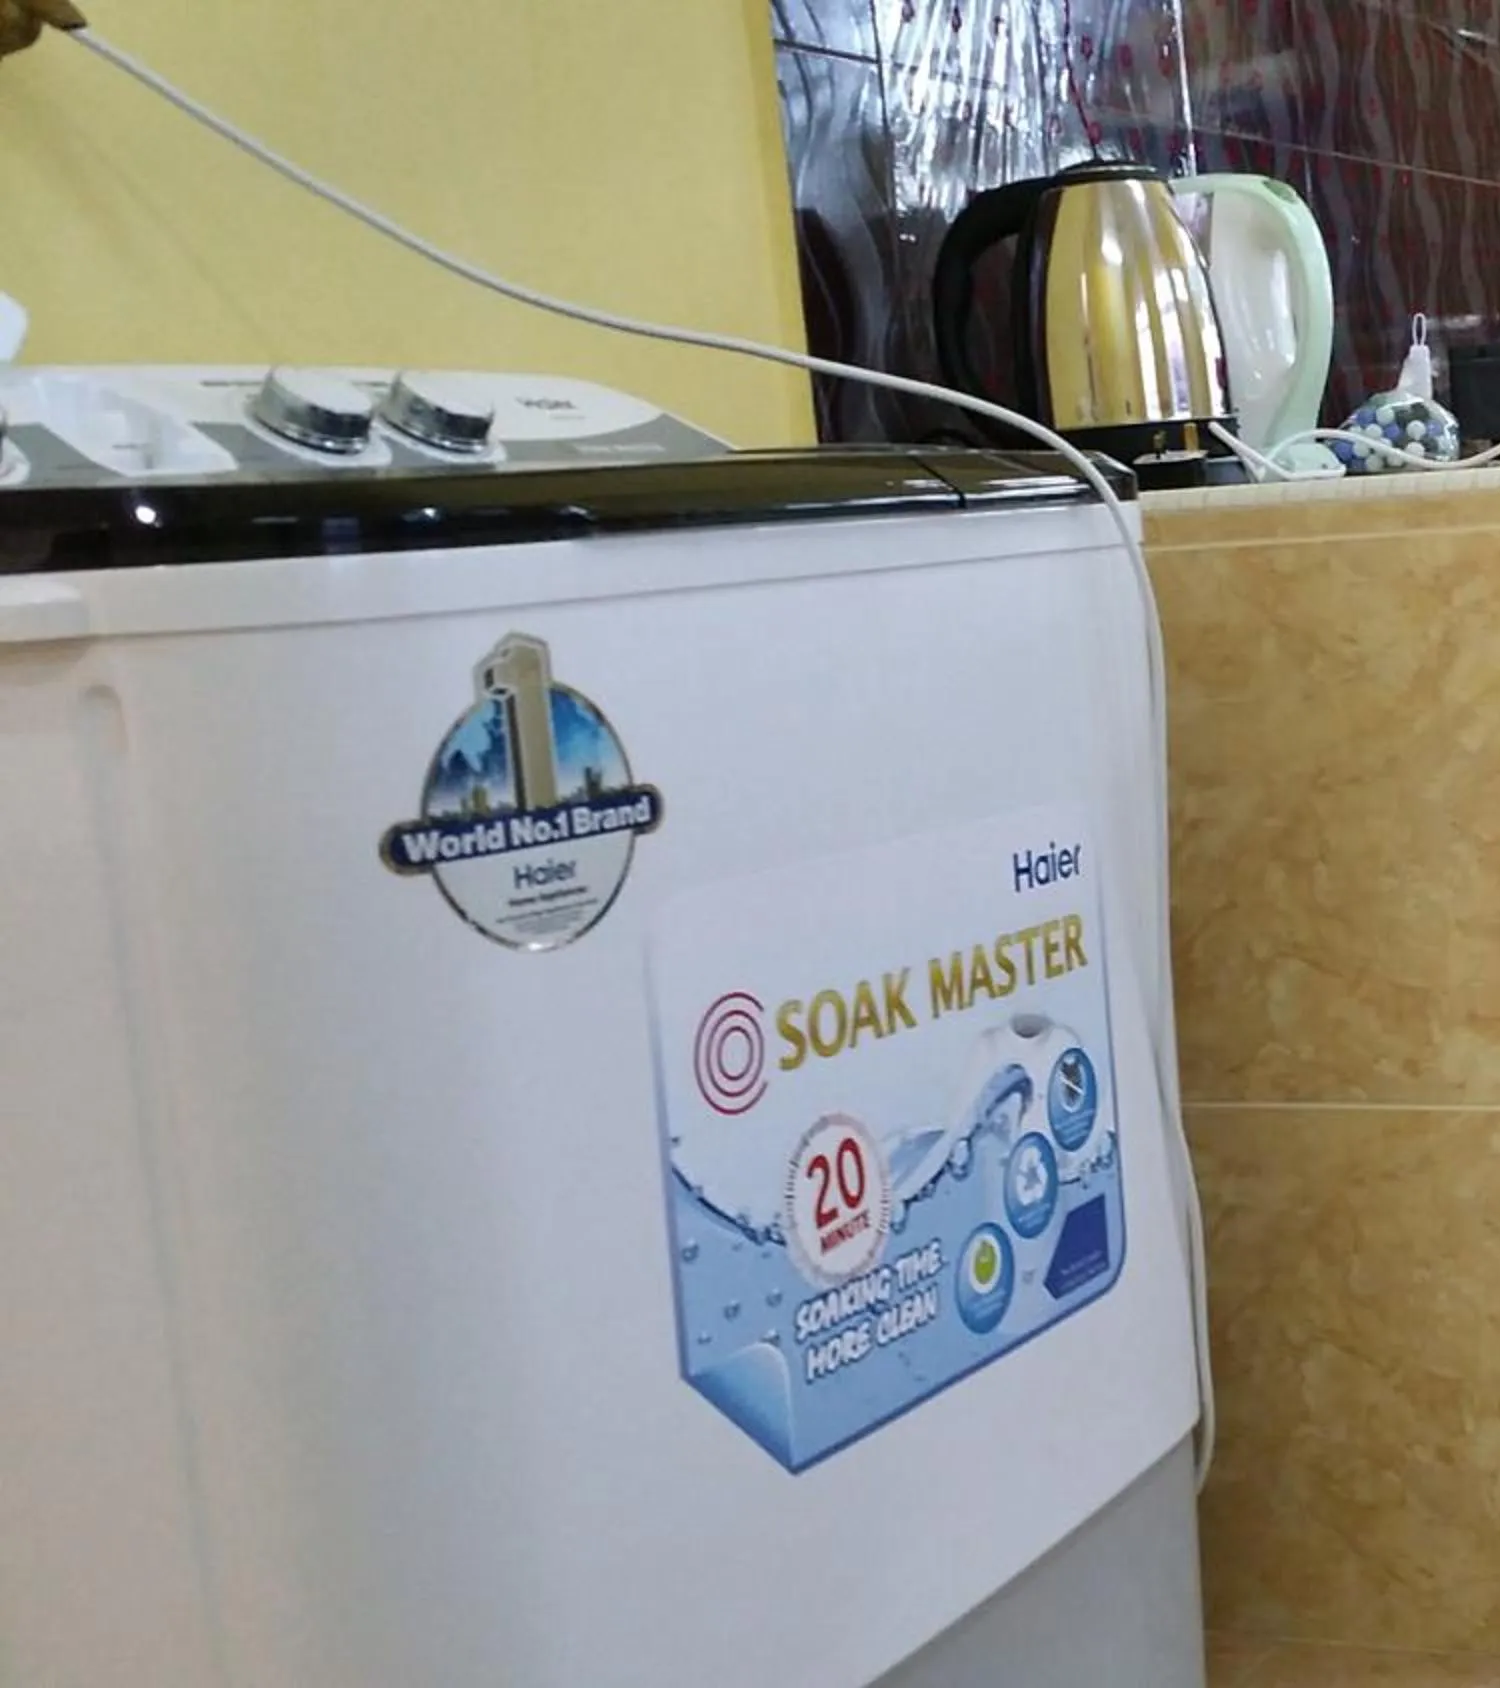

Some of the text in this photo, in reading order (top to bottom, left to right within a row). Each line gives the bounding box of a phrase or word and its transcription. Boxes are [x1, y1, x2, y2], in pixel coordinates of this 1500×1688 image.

[403, 796, 651, 864] World No.1 Brand
[513, 858, 577, 890] Haier
[1013, 841, 1082, 893] Haier
[776, 913, 1089, 1071] SOAK MASTER
[807, 1137, 867, 1229] 20
[815, 1208, 870, 1257] MINUTE
[807, 1320, 871, 1381] MORE
[877, 1284, 938, 1345] CLEAN
